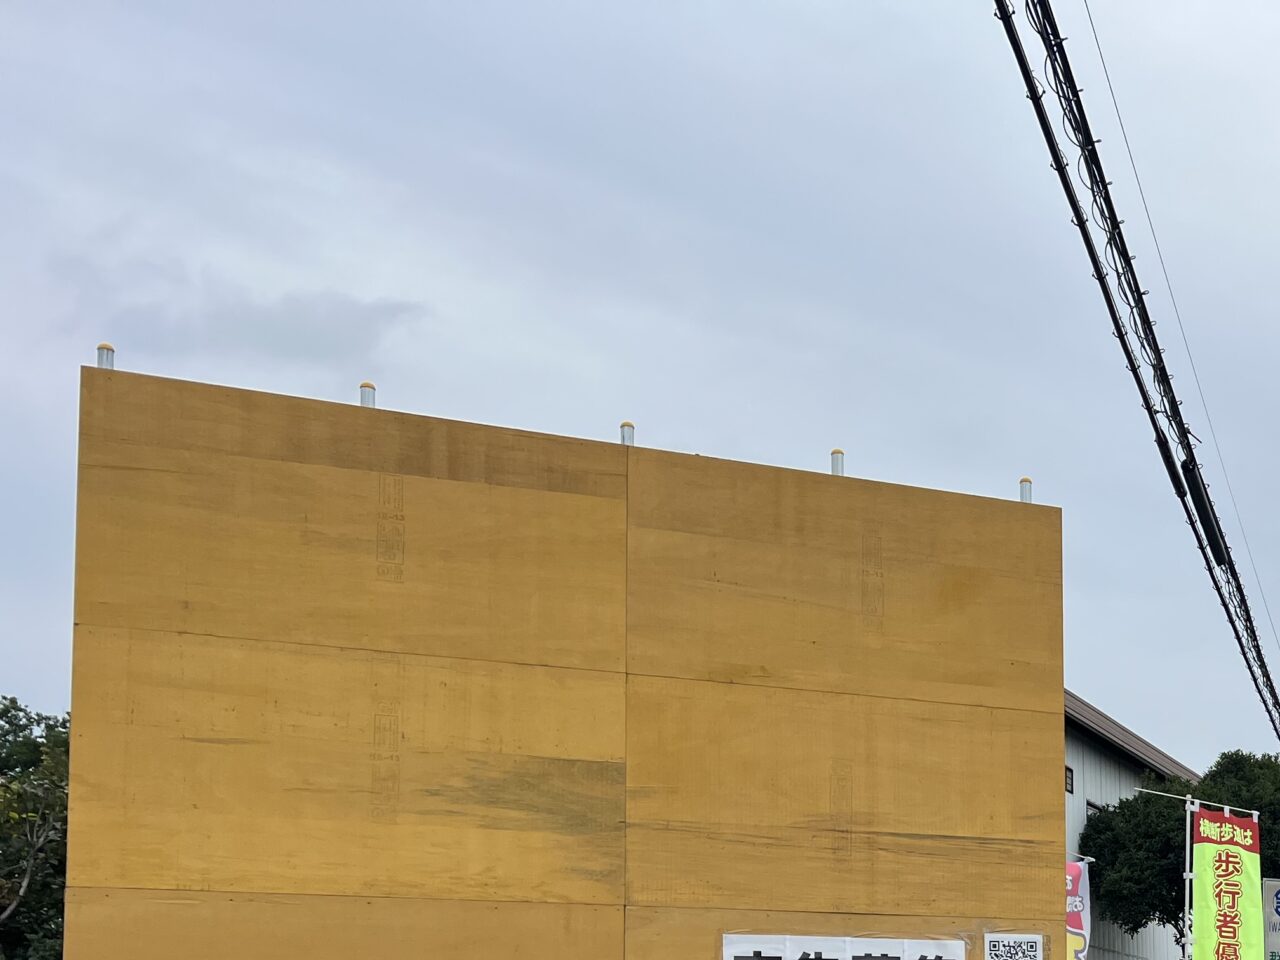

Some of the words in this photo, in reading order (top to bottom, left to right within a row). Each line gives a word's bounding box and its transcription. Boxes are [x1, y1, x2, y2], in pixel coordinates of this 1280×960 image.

[1199, 817, 1253, 846] 横断歩道は
